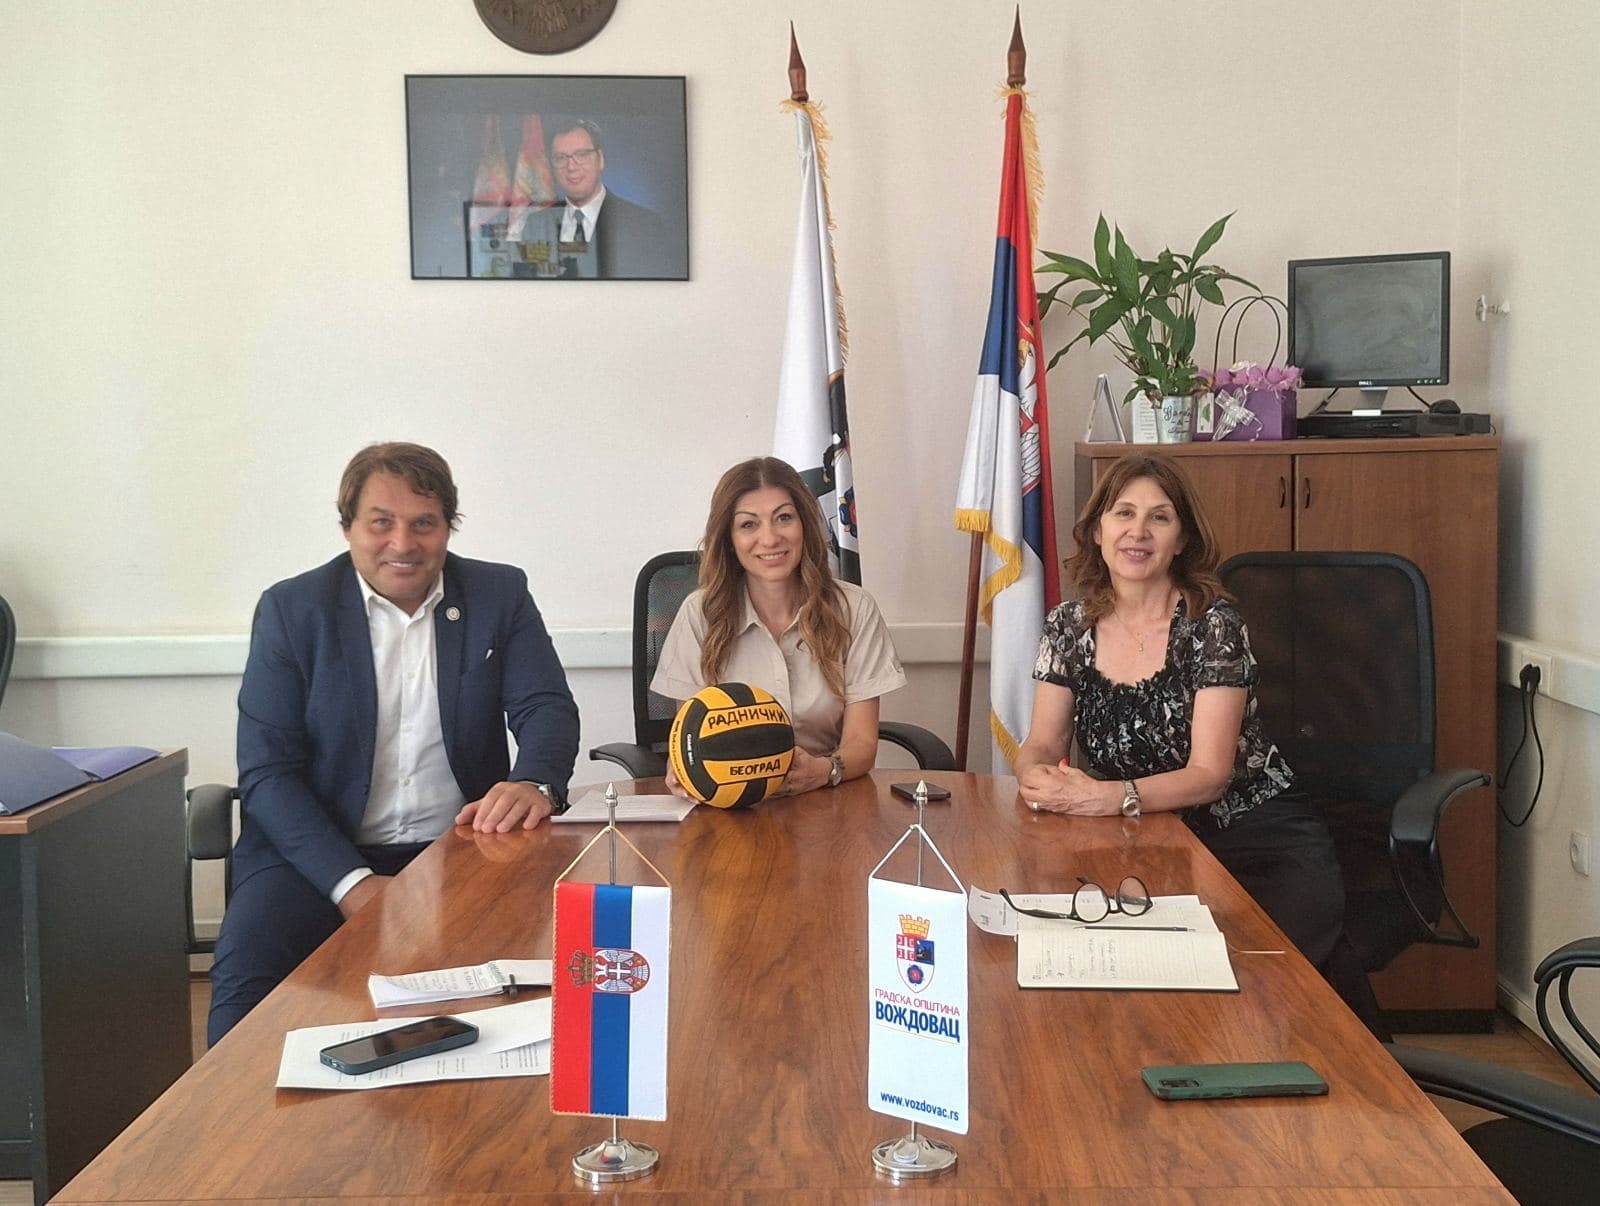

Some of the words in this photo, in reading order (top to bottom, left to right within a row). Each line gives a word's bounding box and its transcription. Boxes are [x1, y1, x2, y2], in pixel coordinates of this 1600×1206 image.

[708, 708, 785, 729] РАДНИЧКИ
[729, 758, 781, 776] БЕОГРАД
[874, 987, 912, 1006] ГРАДСКА
[913, 998, 960, 1017] ОПШТИНА
[875, 1000, 960, 1043] ВОЖДОВАЦ
[880, 1091, 959, 1121] www.vozdovac.rs
